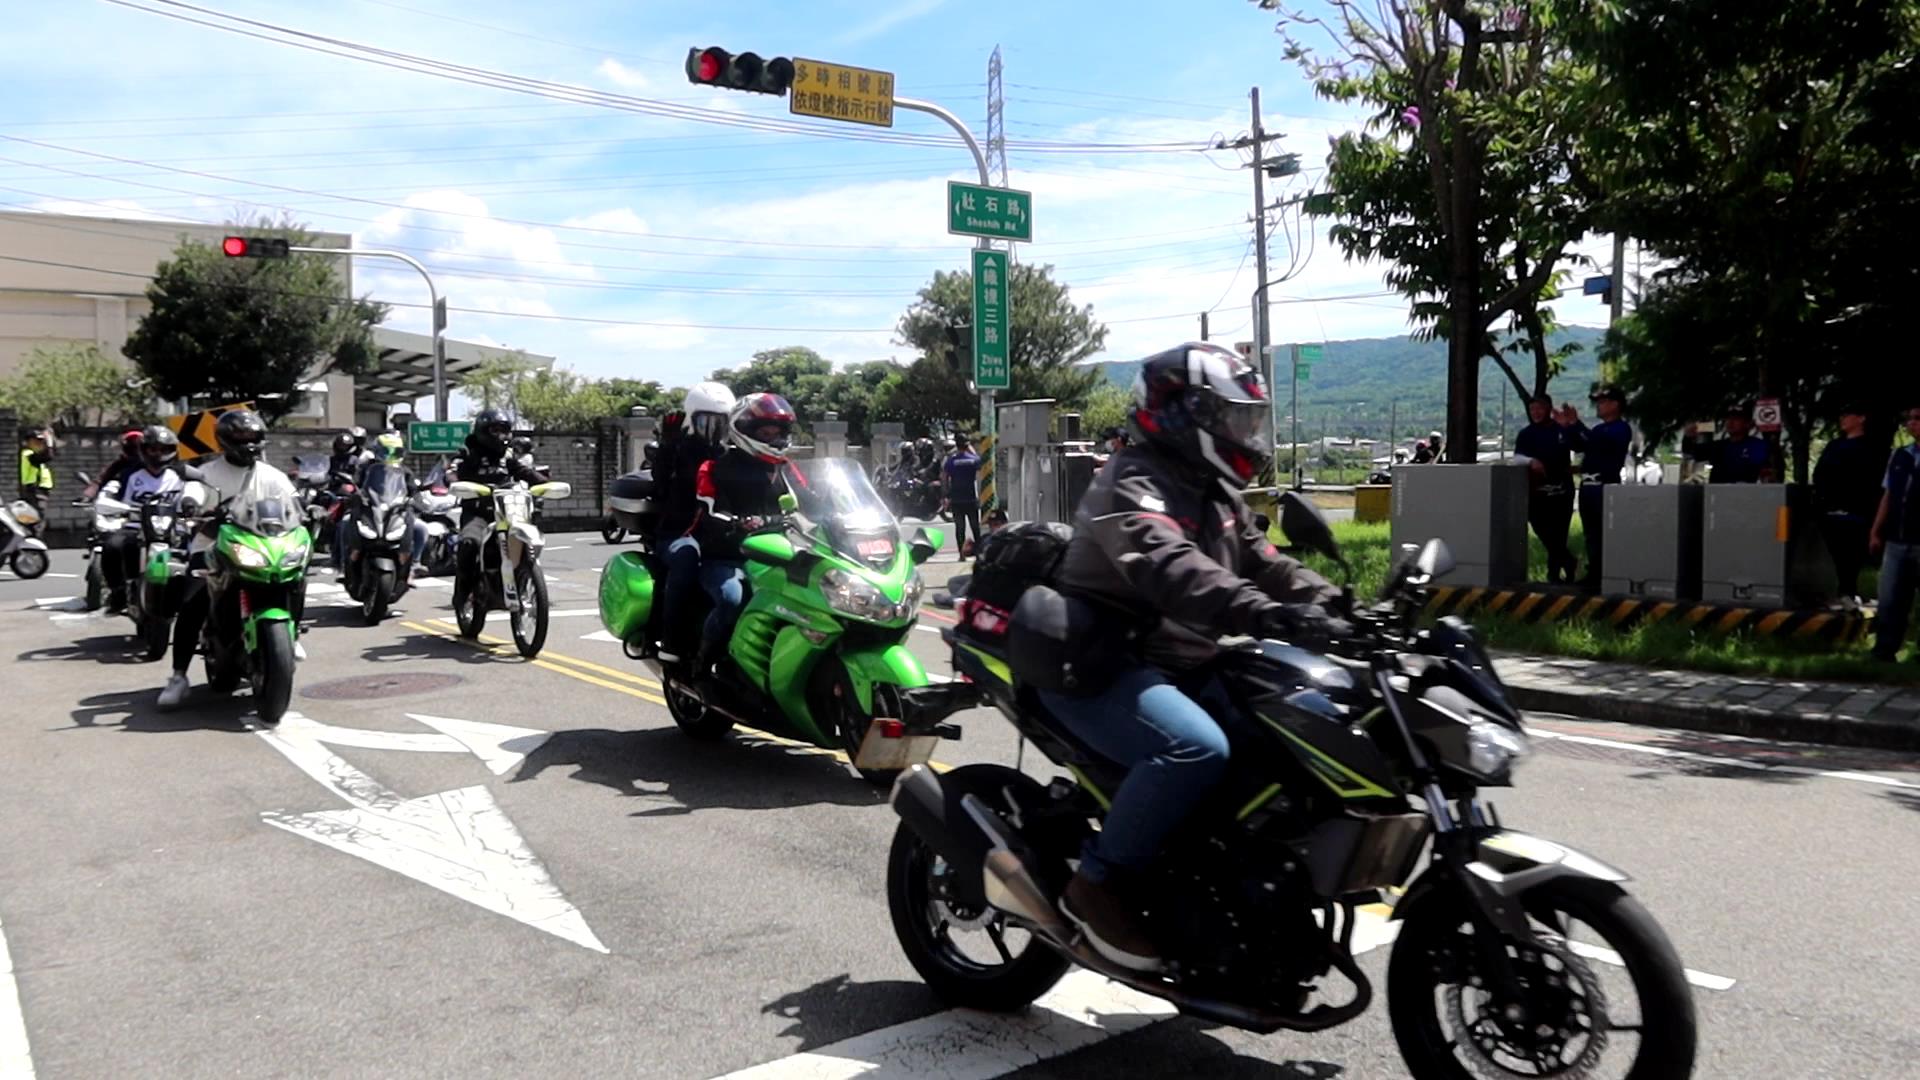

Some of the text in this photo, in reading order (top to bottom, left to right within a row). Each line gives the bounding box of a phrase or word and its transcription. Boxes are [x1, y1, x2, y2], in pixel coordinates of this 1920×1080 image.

[797, 63, 891, 97] 多時相號誌
